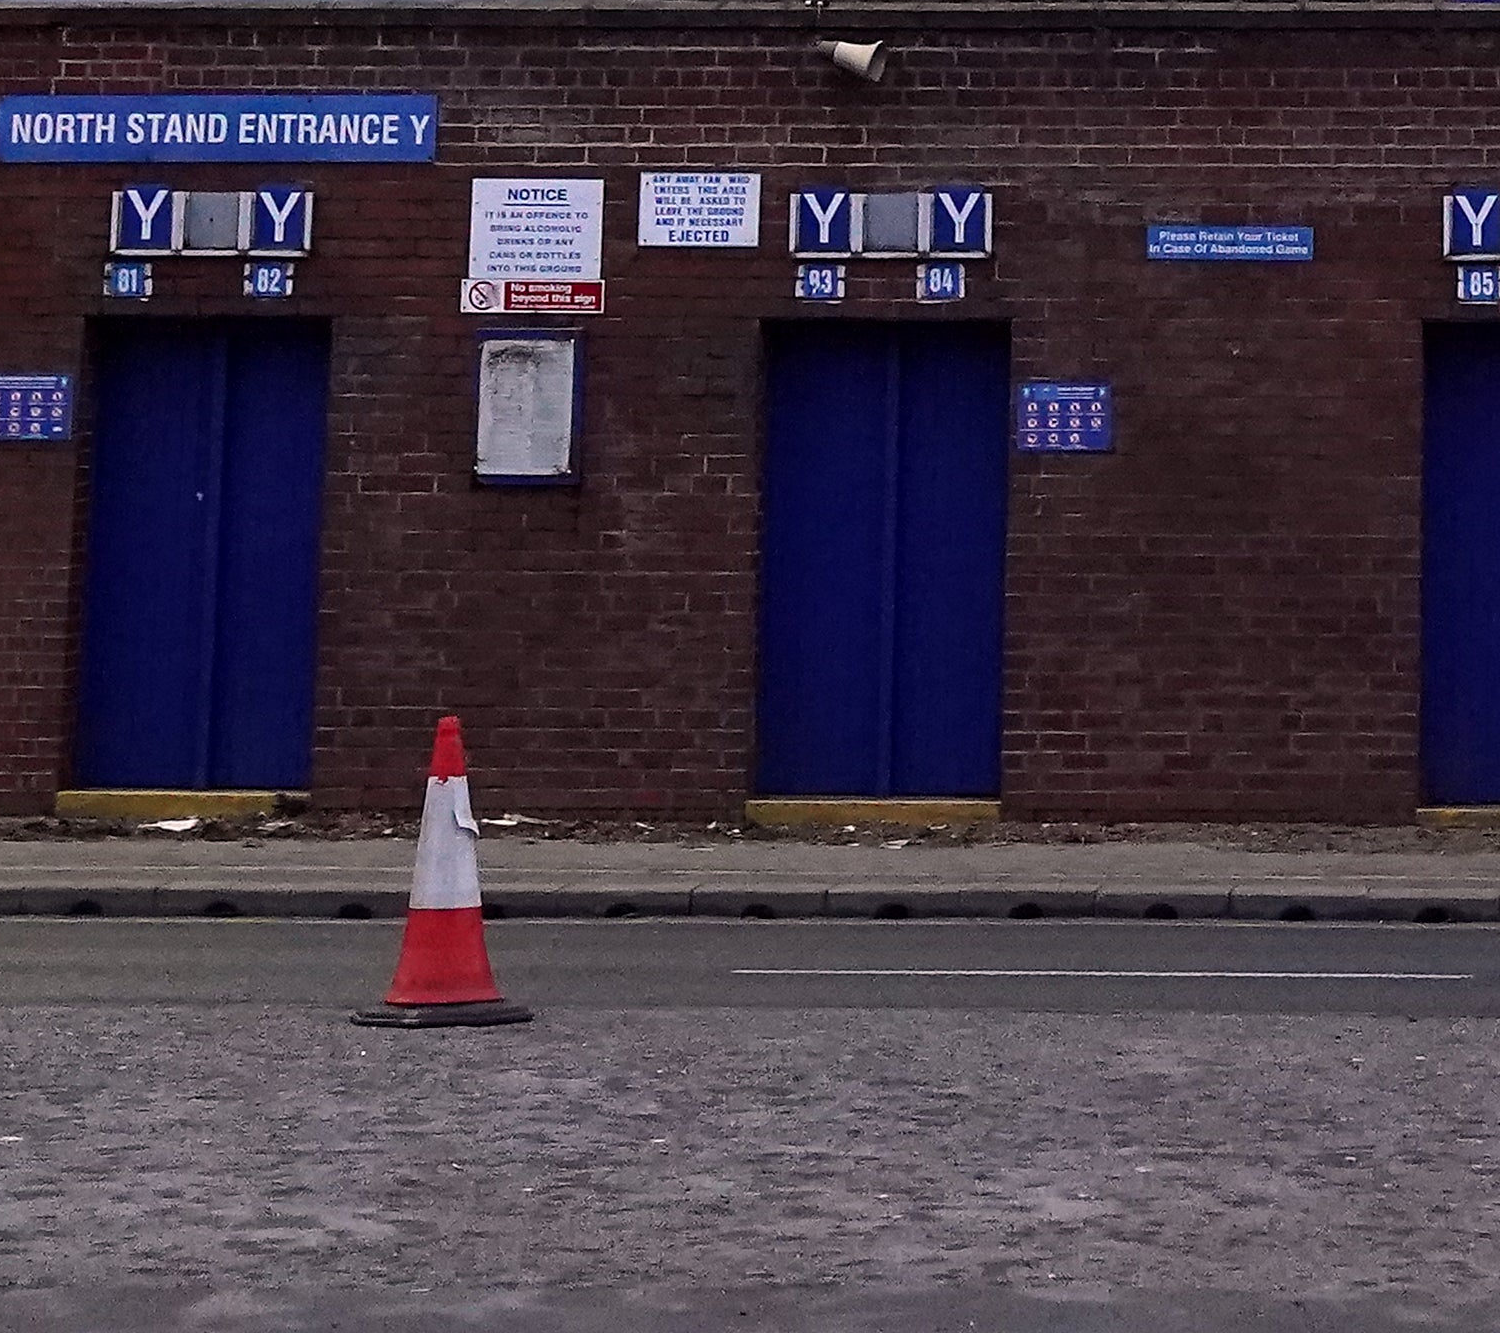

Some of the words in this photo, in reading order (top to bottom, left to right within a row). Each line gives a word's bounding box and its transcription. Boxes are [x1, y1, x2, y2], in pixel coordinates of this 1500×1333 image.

[12, 114, 115, 143] NORTH
[127, 114, 228, 143] STAND
[239, 115, 399, 145] ENTRANCE
[410, 115, 429, 145] Y
[508, 189, 567, 201] NOTICE
[700, 197, 729, 205] ASKED
[734, 197, 745, 205] TO
[127, 189, 168, 240] Y
[260, 192, 300, 242] Y
[804, 193, 845, 243] Y
[938, 193, 980, 243] Y
[1456, 195, 1497, 246] Y
[689, 218, 743, 226] NECESSARY
[669, 230, 729, 242] EJECTED
[1159, 232, 1196, 241] Please
[1199, 232, 1234, 241] Retain
[1237, 232, 1263, 241] Your
[1266, 232, 1298, 241] Ticket
[1150, 245, 1160, 253] In
[1163, 244, 1191, 253] Case
[1194, 244, 1207, 253] Of
[1210, 244, 1273, 254] Abandoned
[1276, 245, 1308, 254] Game
[930, 268, 952, 292] 84
[1471, 272, 1493, 295] 85
[529, 284, 572, 293] smoking
[511, 294, 548, 303] beyond
[552, 294, 570, 302] this
[574, 295, 595, 304] sign
